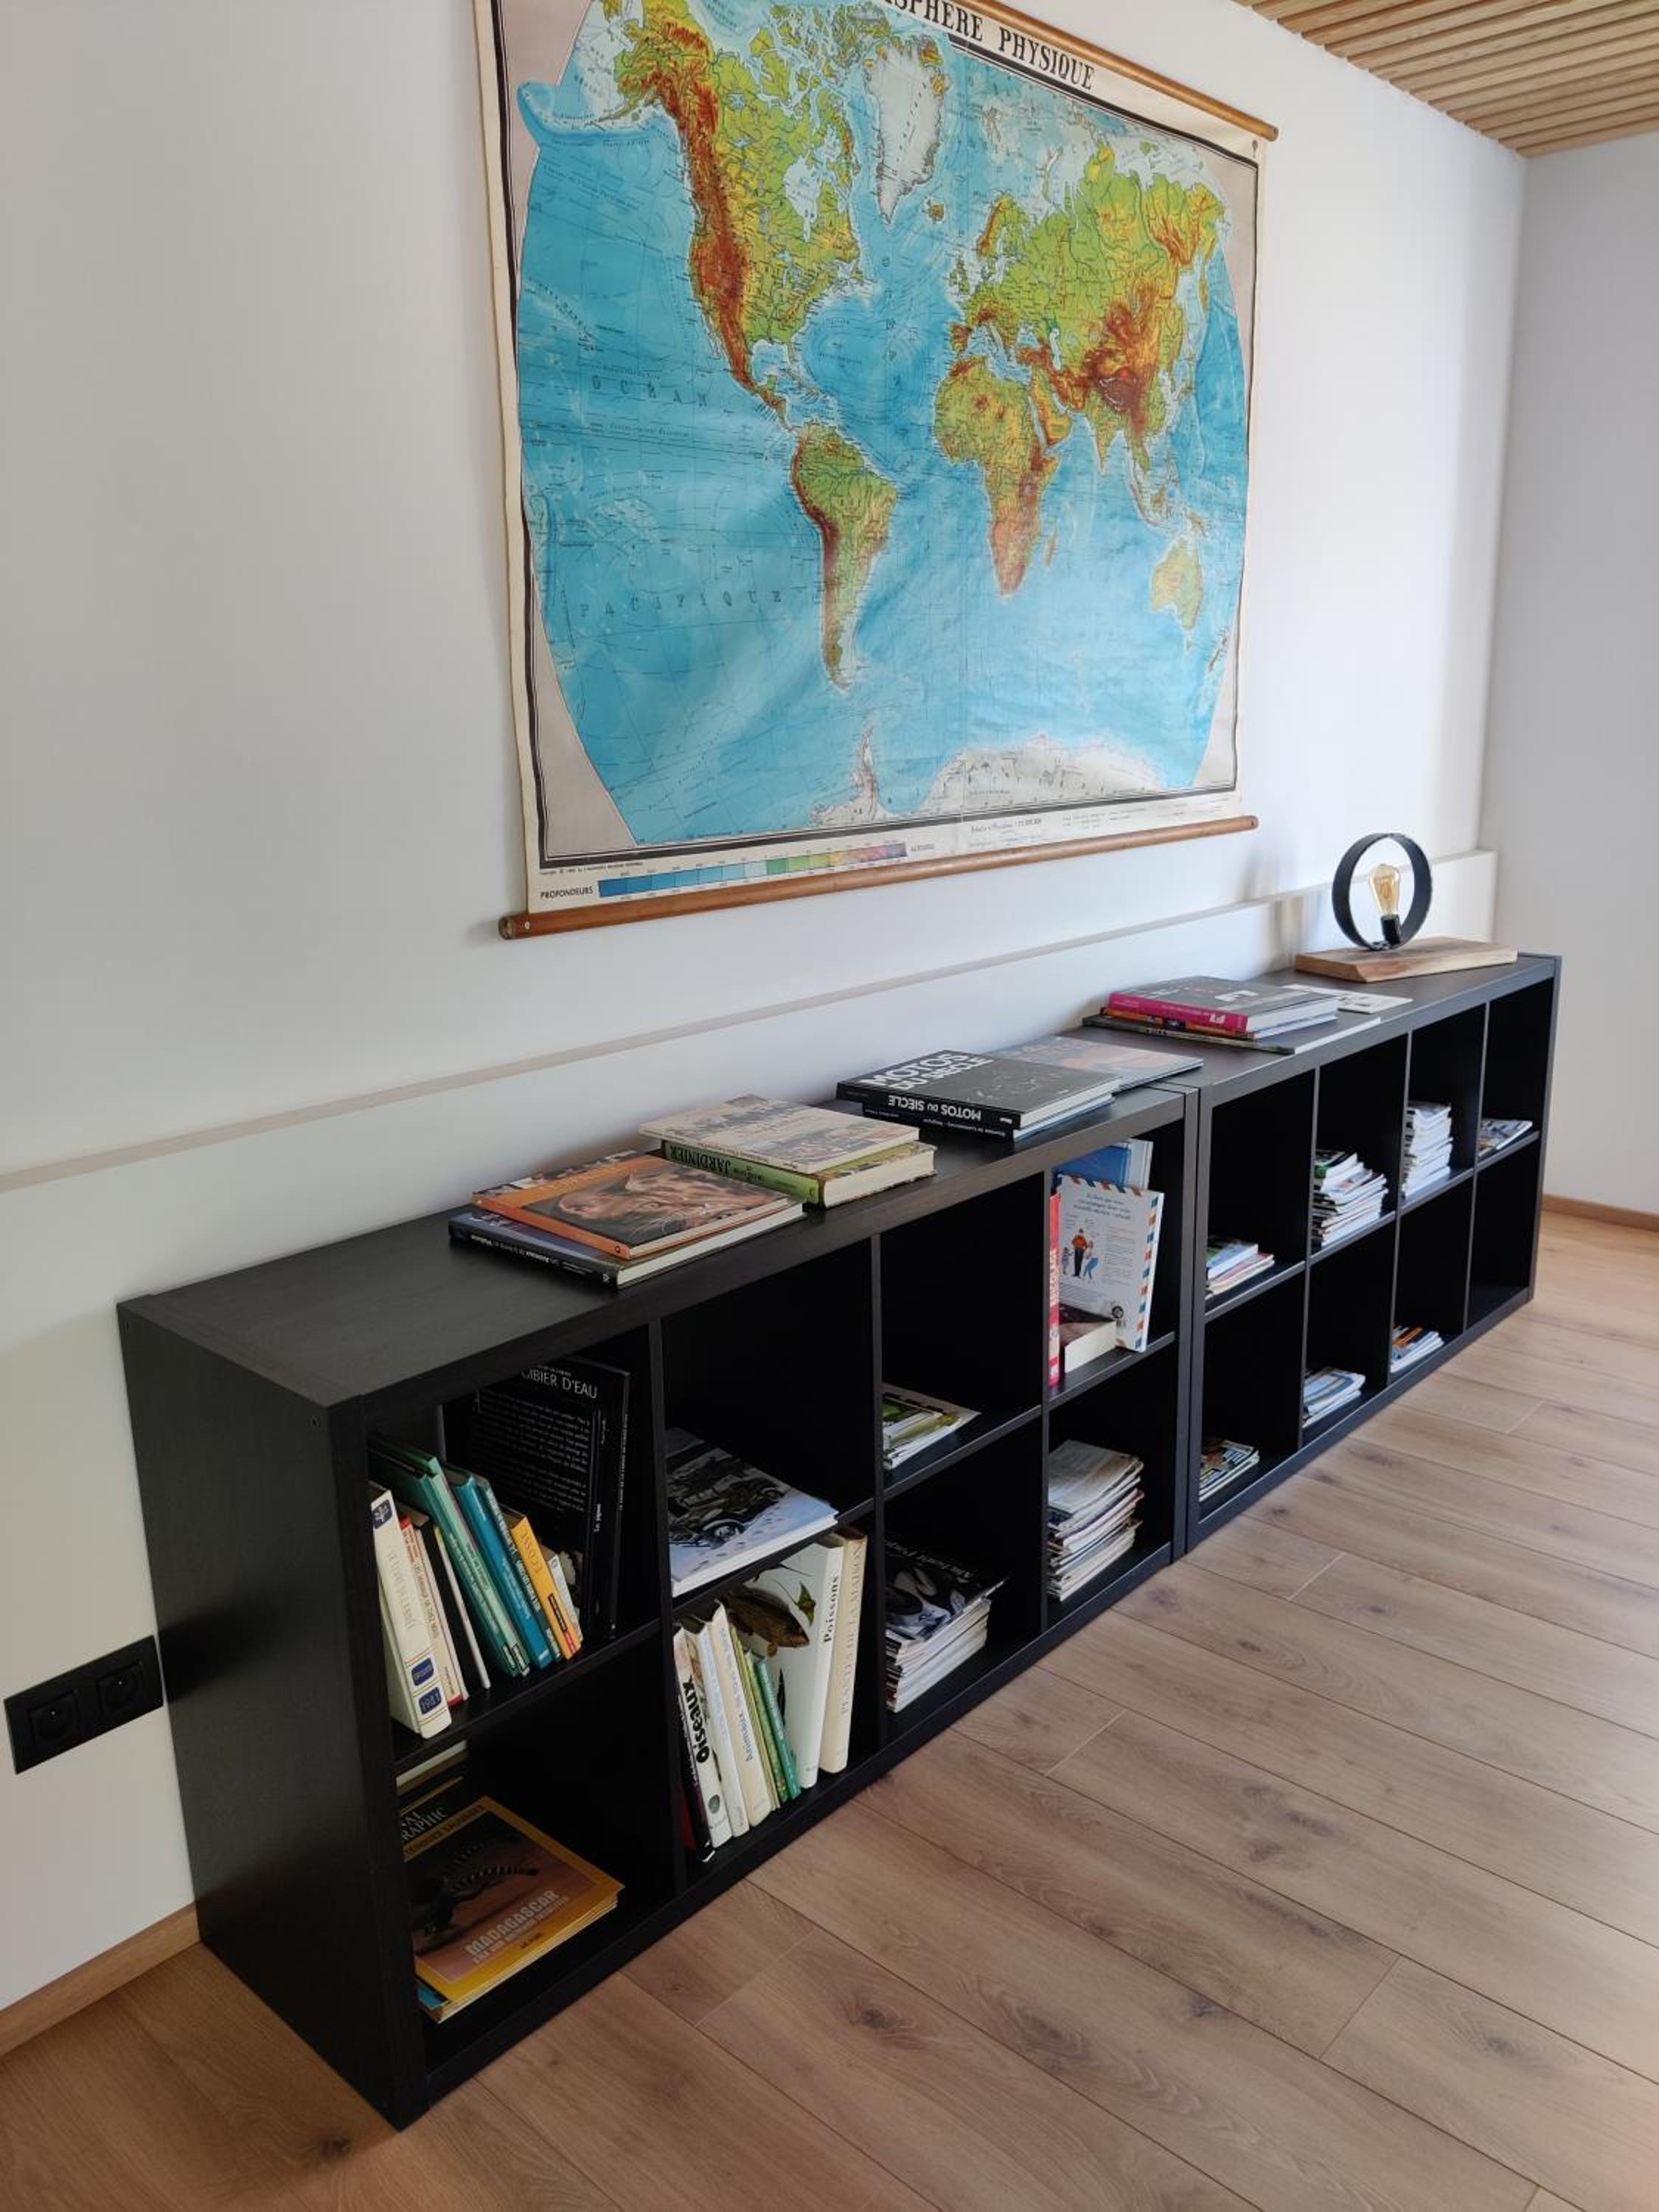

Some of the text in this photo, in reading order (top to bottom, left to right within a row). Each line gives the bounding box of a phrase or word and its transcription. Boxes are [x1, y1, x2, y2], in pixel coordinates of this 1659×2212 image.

[887, 0, 1096, 90] PHERE PHYSIQUE
[540, 886, 594, 899] PROFONDEURS
[859, 1054, 969, 1087] MOTOS
[941, 1104, 982, 1121] MOTOS
[669, 1145, 731, 1175] JARDINIER
[561, 1377, 599, 1399] D'EAU
[823, 1575, 839, 1643] Poissons
[682, 1674, 710, 1764] Oiseaux
[401, 1807, 448, 1841] RAPHIC
[465, 1889, 560, 1956] MADAGASCAR
